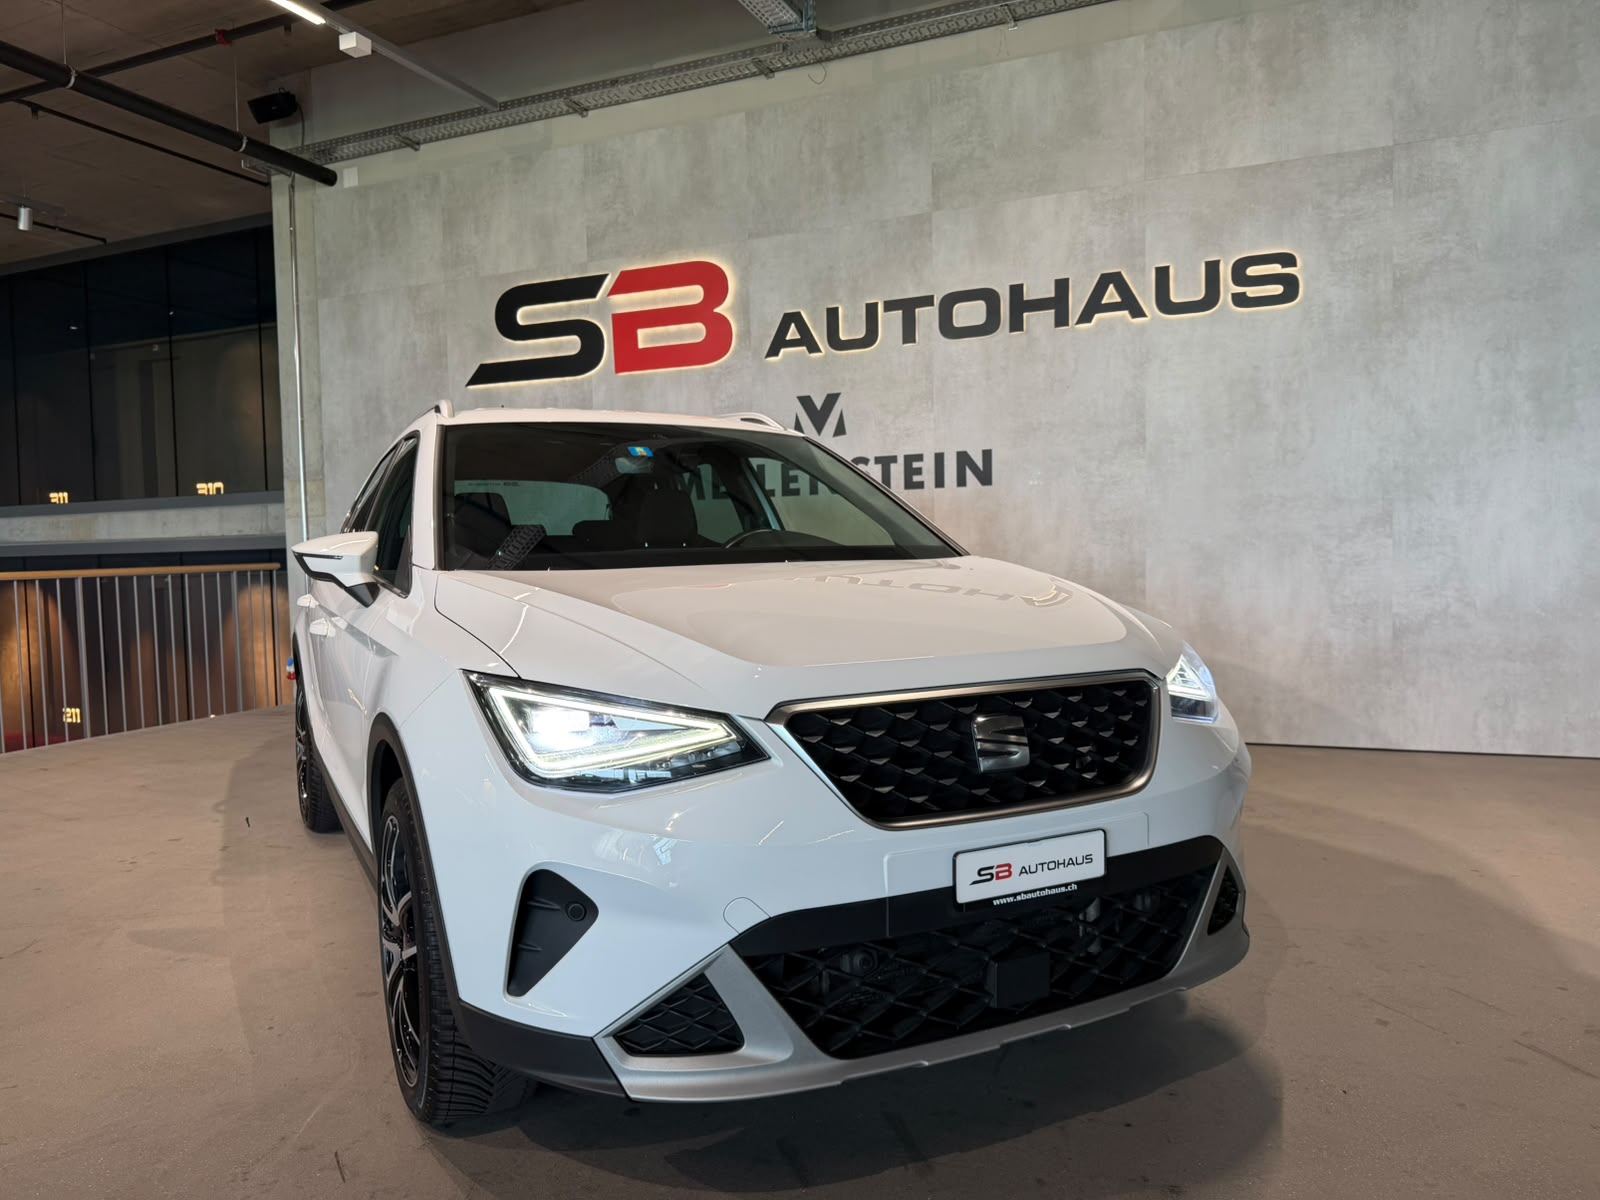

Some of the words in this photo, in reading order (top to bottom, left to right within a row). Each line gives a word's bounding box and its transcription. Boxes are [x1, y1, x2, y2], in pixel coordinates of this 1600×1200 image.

[465, 258, 735, 388] SB
[764, 250, 1302, 360] AUTOHAUS
[969, 863, 1013, 886] SB
[1018, 853, 1094, 877] AUTOHAUS
[992, 882, 1078, 906] www.sbautohaus.ch
